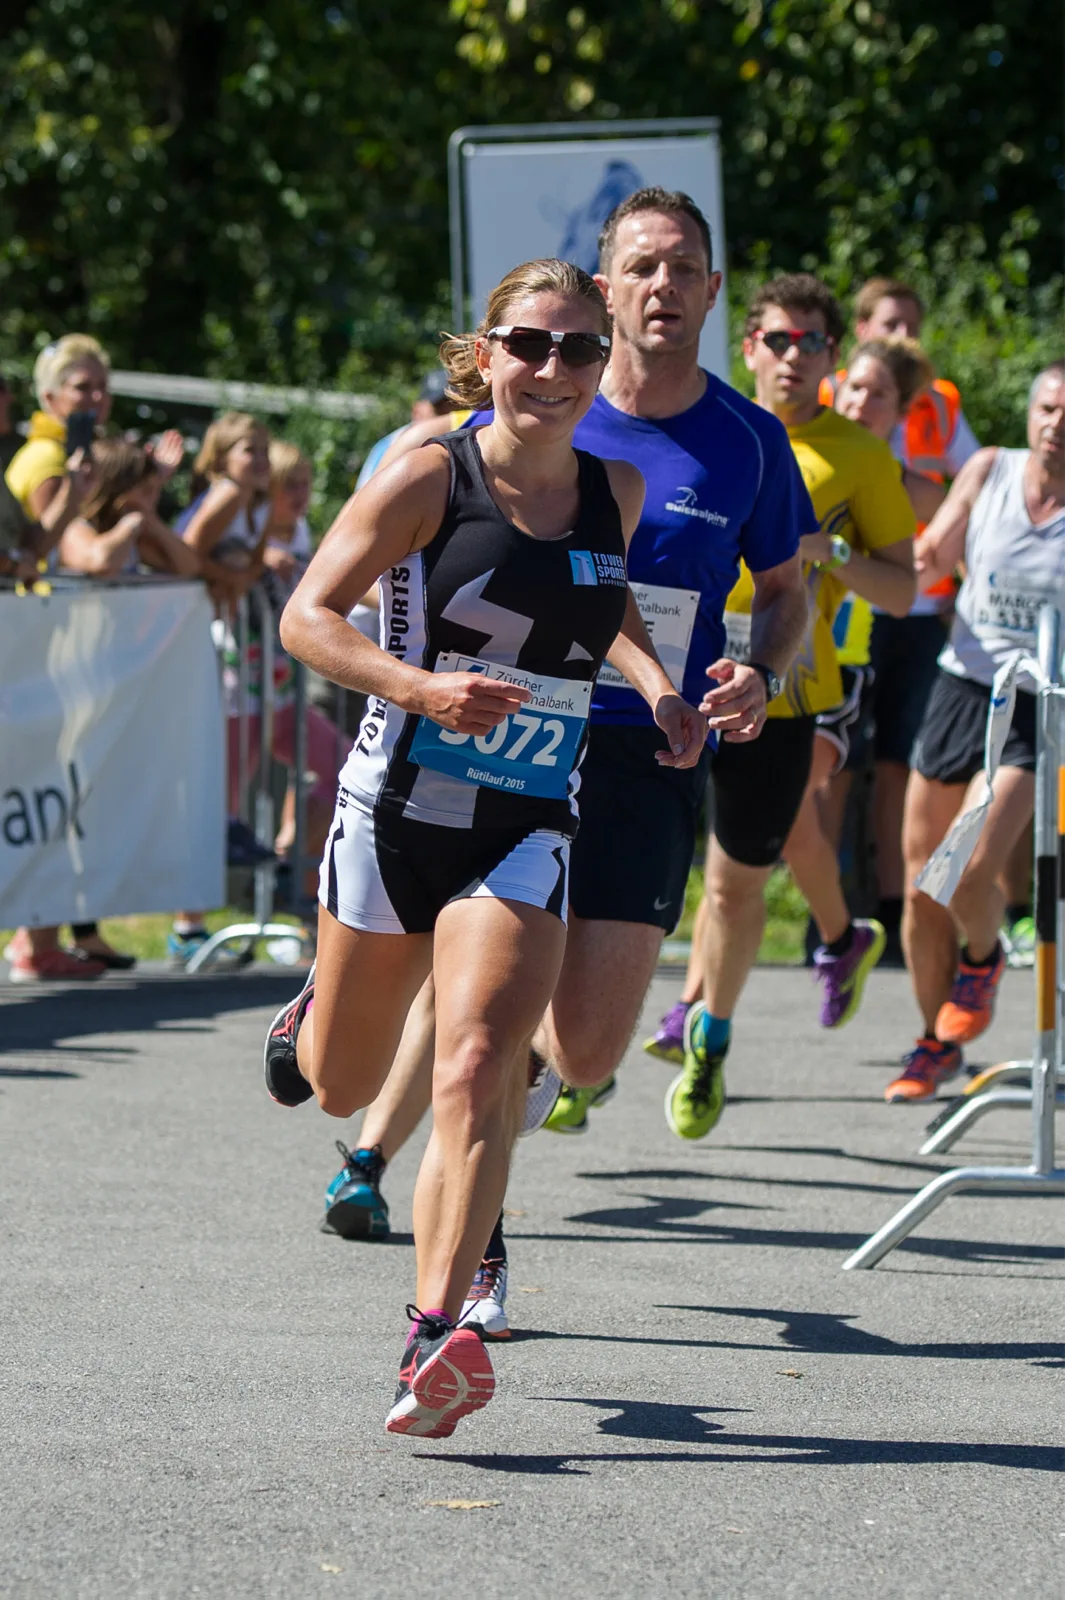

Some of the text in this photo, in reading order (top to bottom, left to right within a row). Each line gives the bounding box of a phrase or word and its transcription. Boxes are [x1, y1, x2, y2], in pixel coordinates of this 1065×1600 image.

[388, 566, 411, 661] PORTS
[495, 670, 544, 693] Zürcher
[466, 767, 526, 790] Rütilauf 2015
